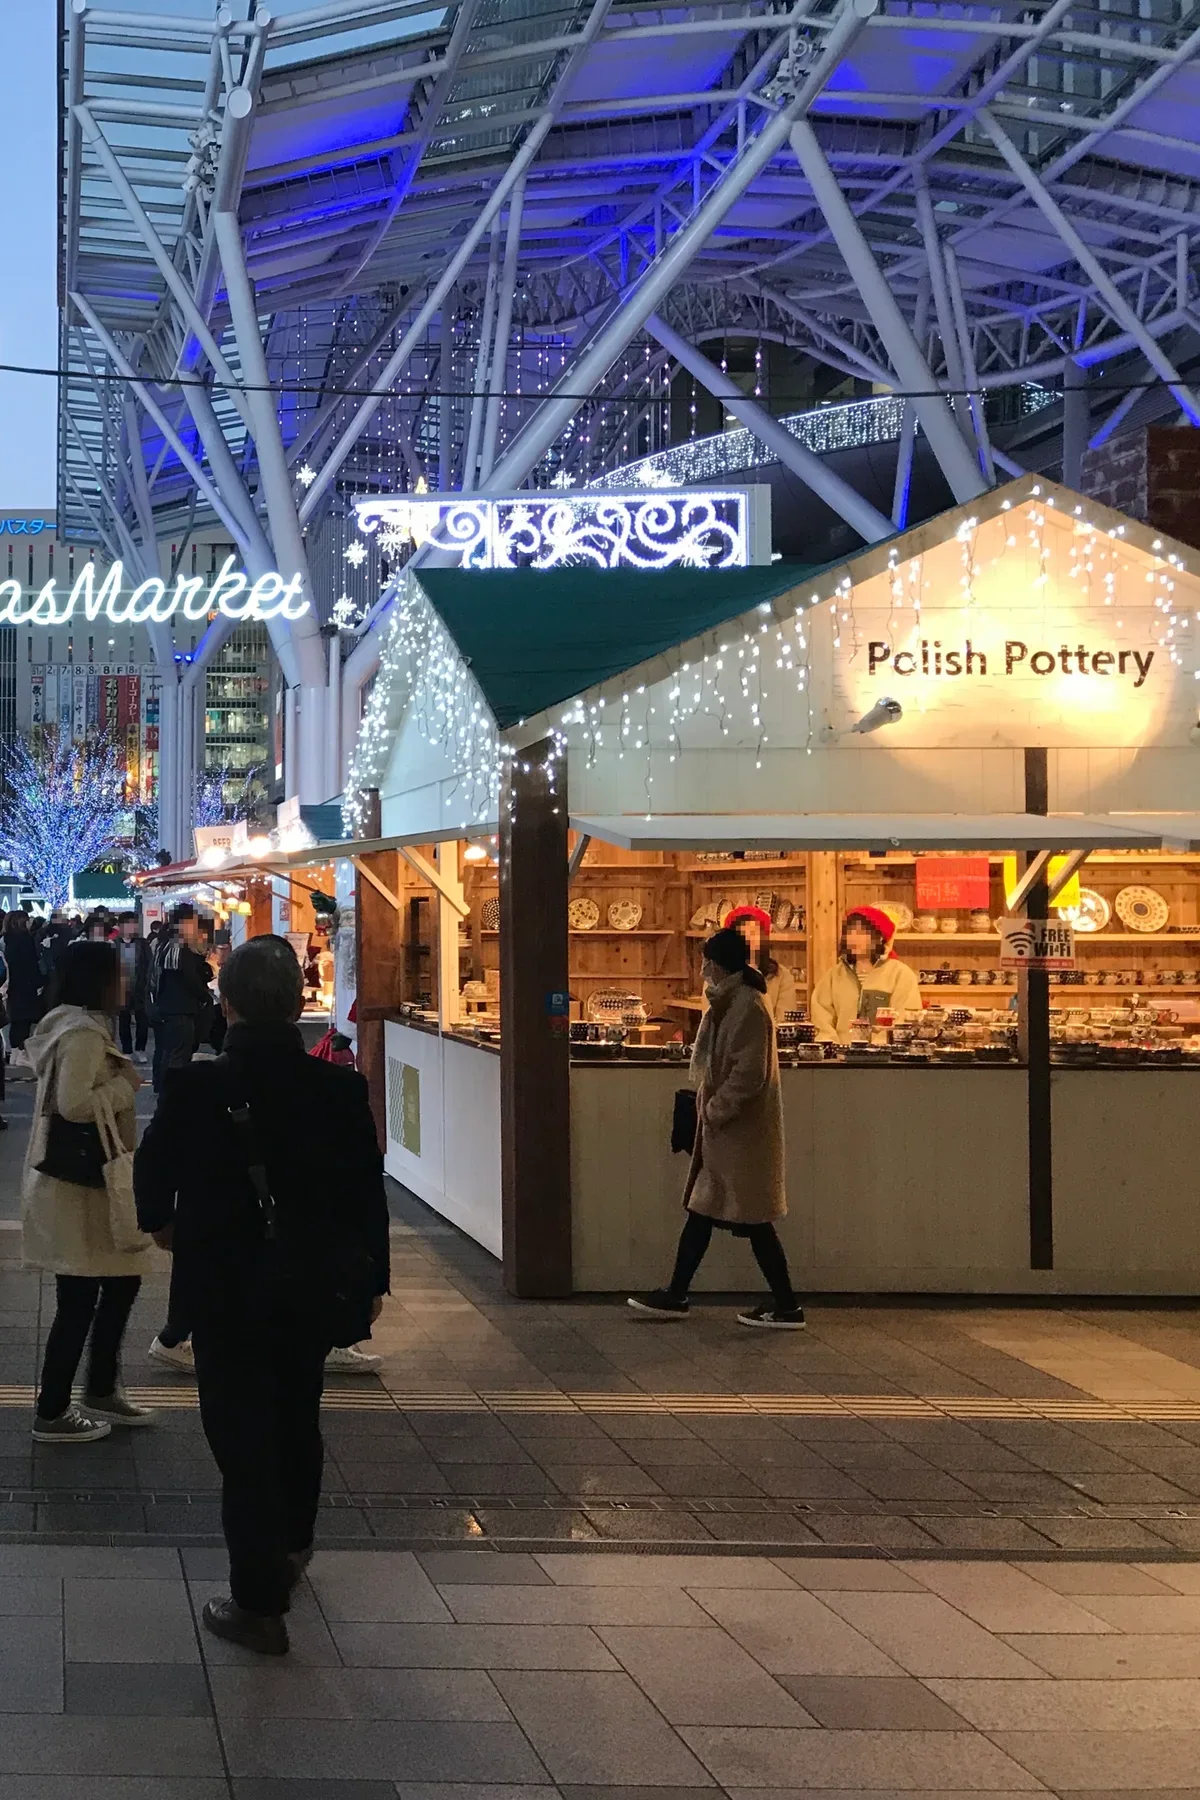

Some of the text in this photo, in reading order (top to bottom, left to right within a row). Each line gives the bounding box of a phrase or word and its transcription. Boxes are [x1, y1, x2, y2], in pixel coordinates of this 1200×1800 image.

[868, 639, 1154, 687] Polish Pottery
[1041, 928, 1071, 943] FREE
